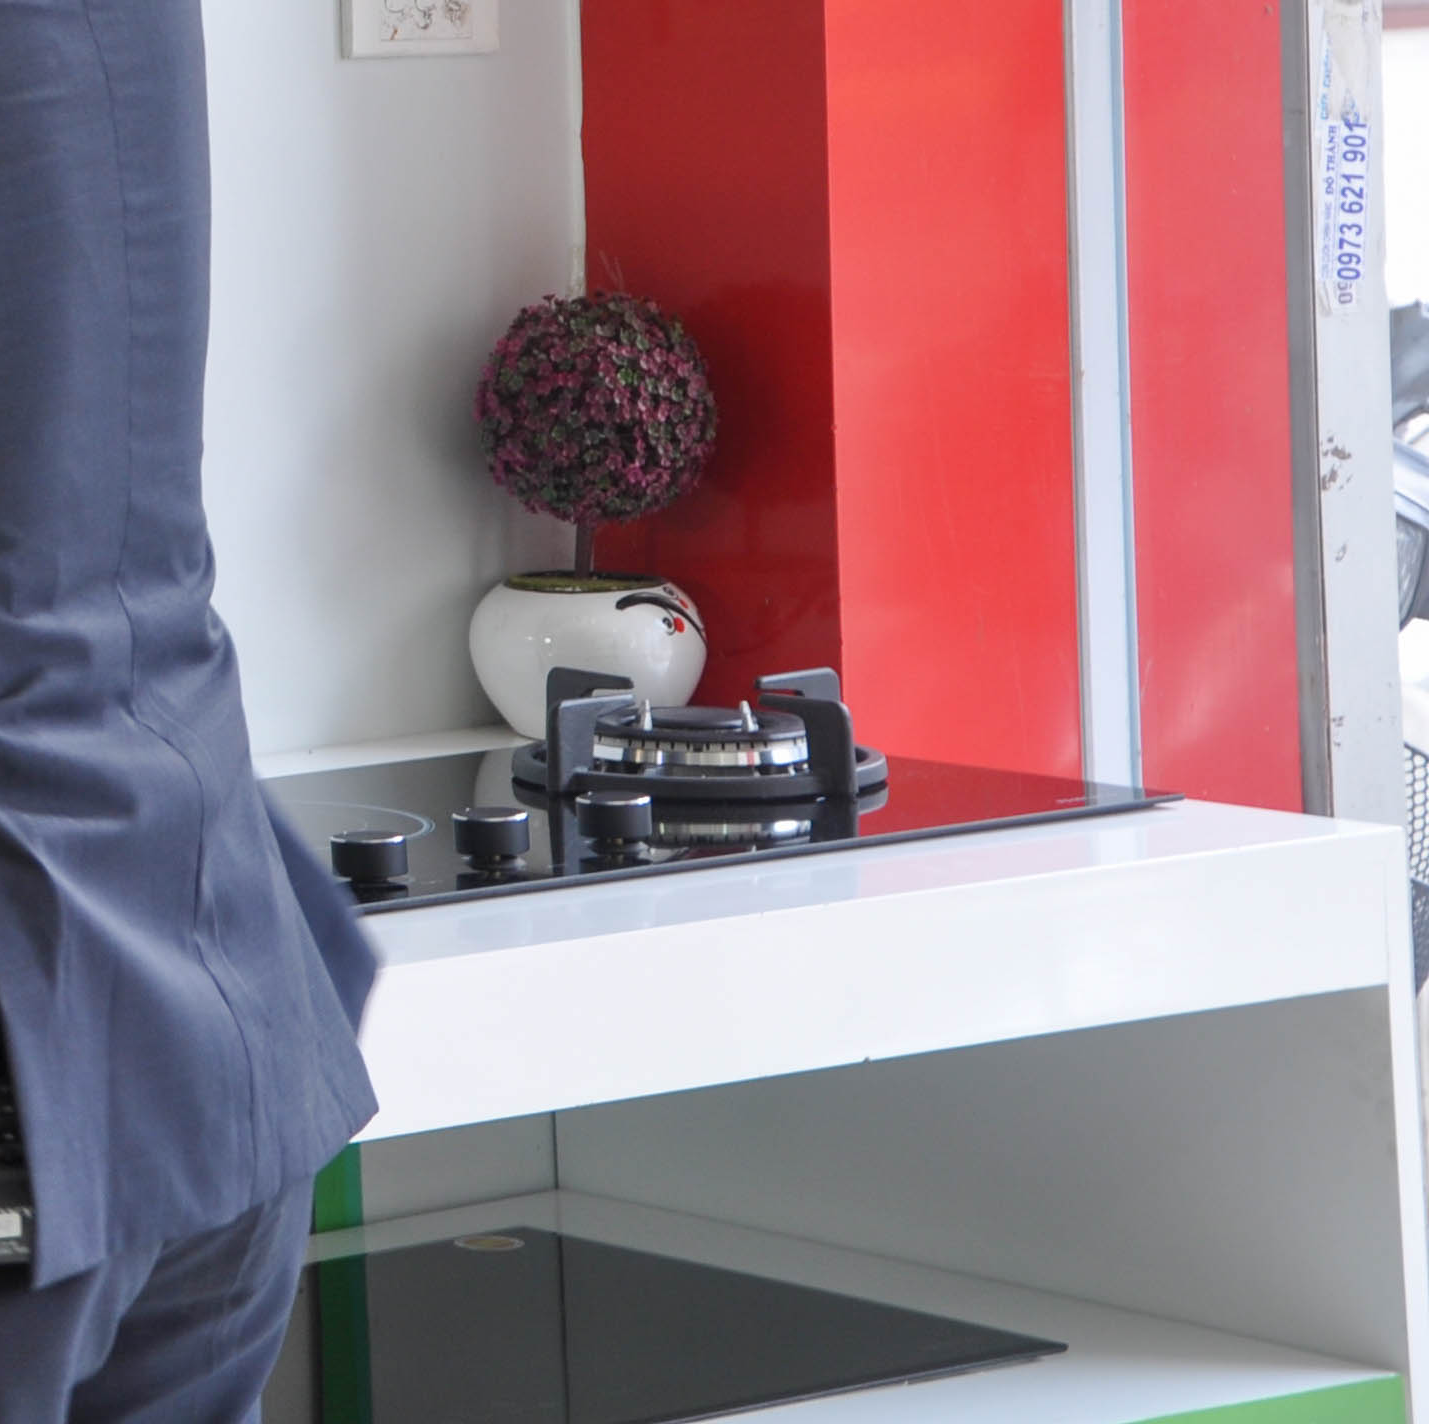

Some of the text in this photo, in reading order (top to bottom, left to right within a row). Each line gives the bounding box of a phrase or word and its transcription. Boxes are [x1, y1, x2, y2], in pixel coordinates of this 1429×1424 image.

[1336, 118, 1367, 280] 0973 621 901
